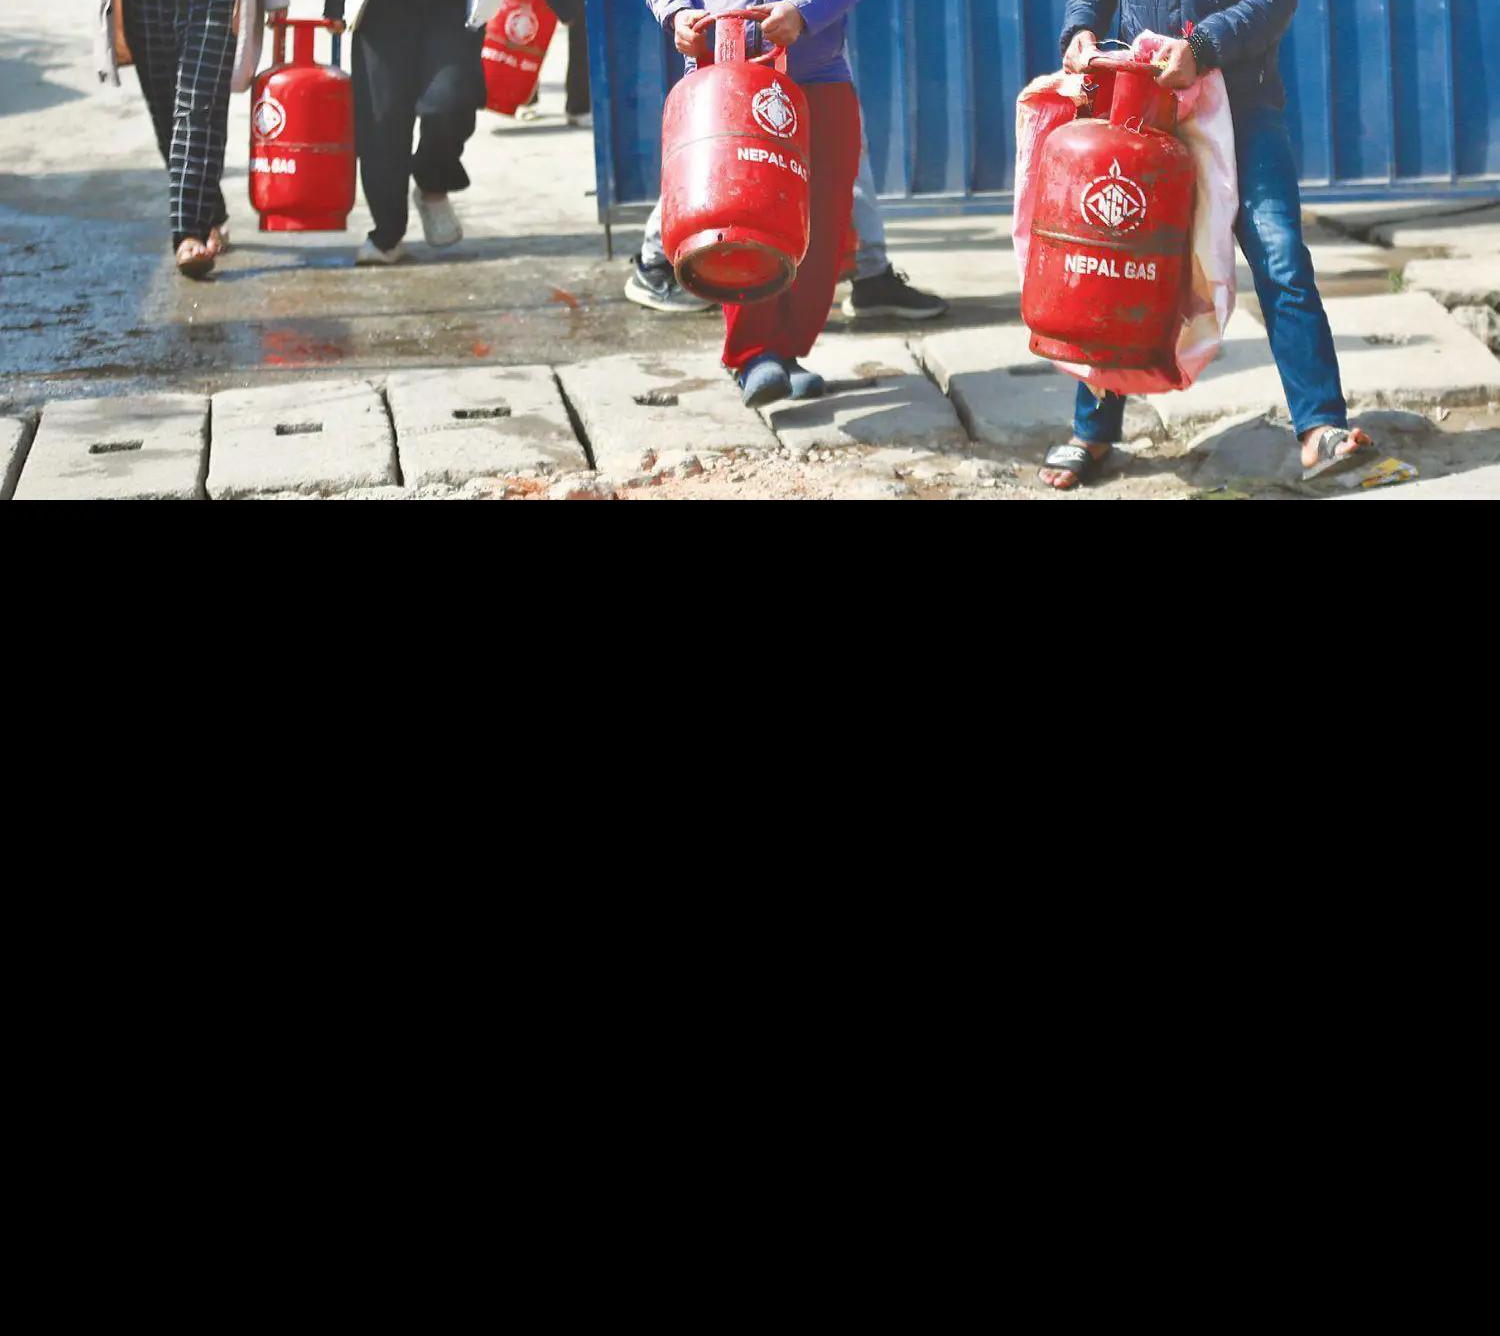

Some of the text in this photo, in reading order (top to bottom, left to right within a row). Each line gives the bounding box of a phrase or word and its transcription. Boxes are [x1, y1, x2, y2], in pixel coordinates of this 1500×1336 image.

[737, 148, 787, 168] NEPAL
[1065, 253, 1156, 280] NEPAL GAS
